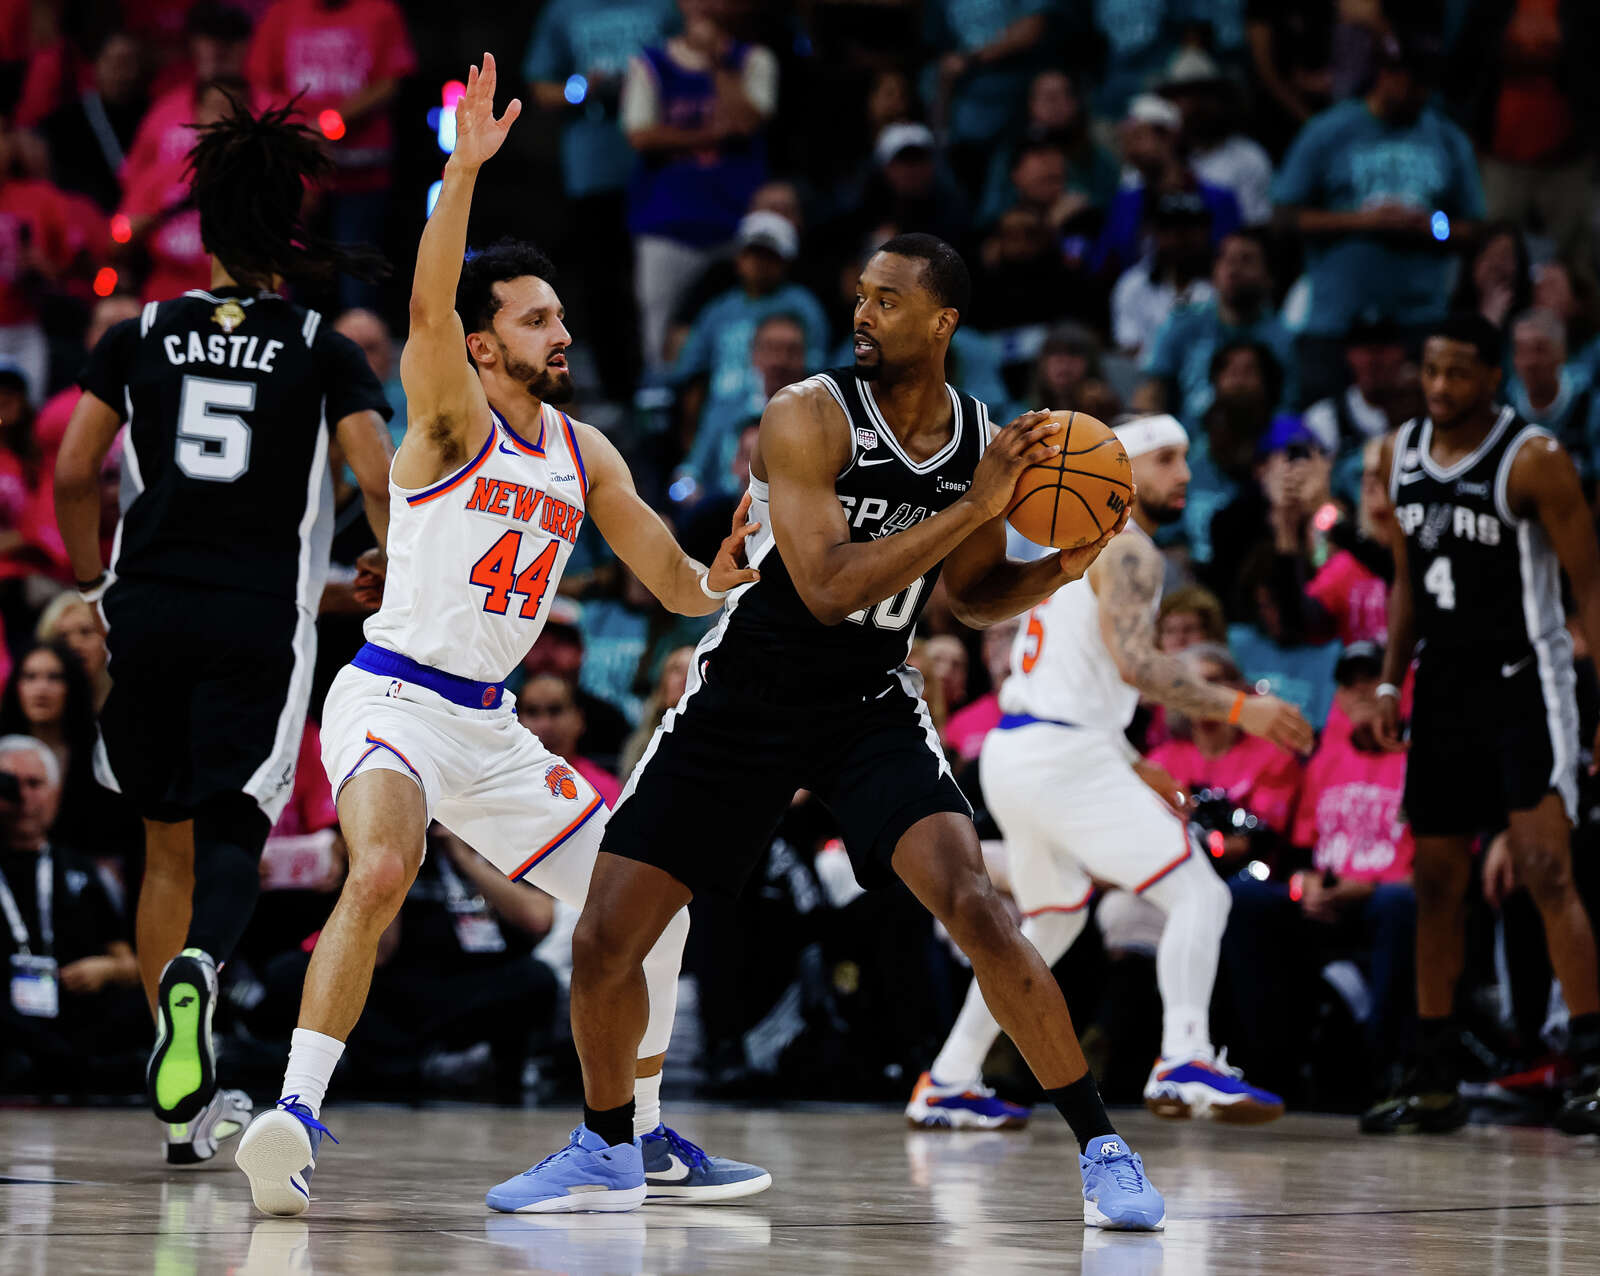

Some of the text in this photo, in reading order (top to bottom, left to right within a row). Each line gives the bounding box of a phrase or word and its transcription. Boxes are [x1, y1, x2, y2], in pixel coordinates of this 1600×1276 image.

[163, 331, 284, 373] CASTLE
[174, 374, 257, 483] 5
[466, 477, 584, 545] NEW ORK
[941, 481, 967, 492] LEDGER
[469, 529, 560, 620] 44
[846, 576, 925, 631] 0
[1424, 556, 1456, 611] 4
[1021, 598, 1052, 674] 5
